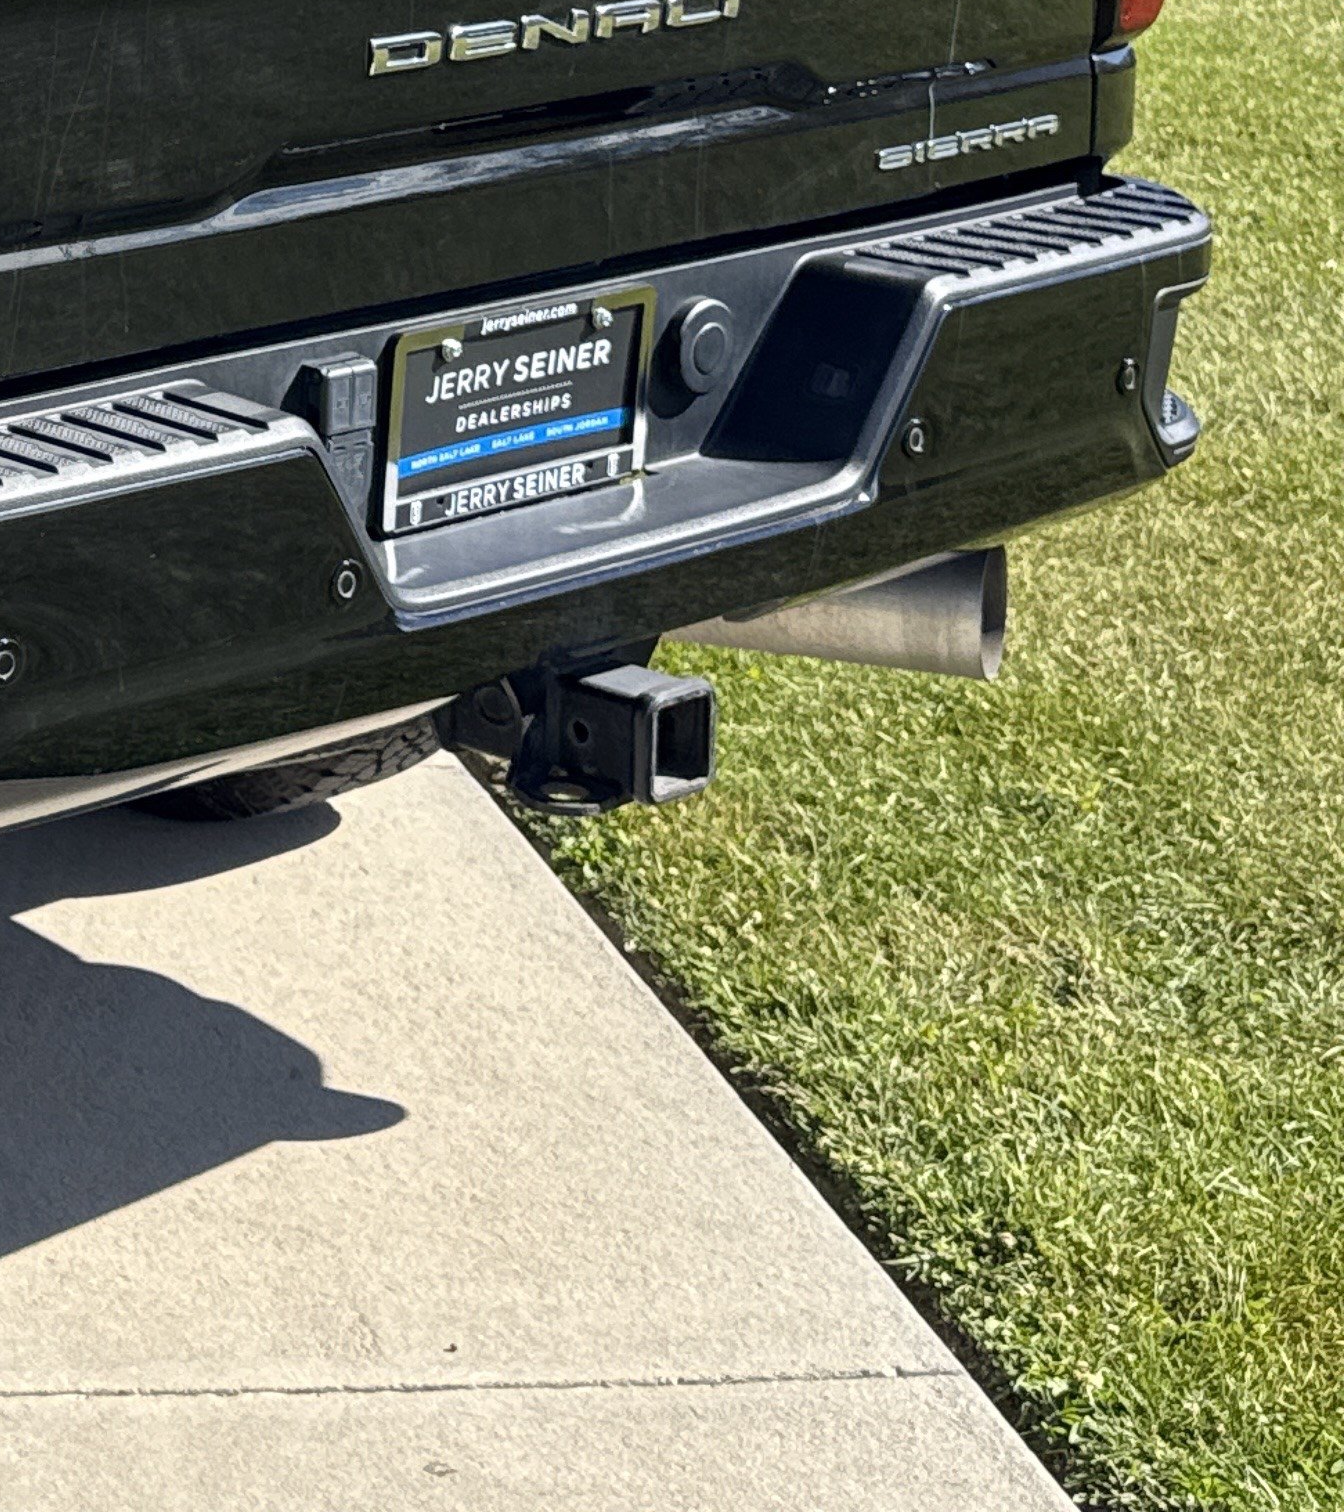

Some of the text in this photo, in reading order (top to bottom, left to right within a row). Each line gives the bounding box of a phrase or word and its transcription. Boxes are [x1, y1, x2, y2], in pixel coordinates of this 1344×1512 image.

[878, 114, 1059, 171] SIERRA
[480, 302, 578, 336] jerryseiner.com
[424, 338, 612, 404] JERRY SEINER
[455, 392, 572, 433] DEALERSHIPS
[444, 462, 587, 517] JERRY SEINER
